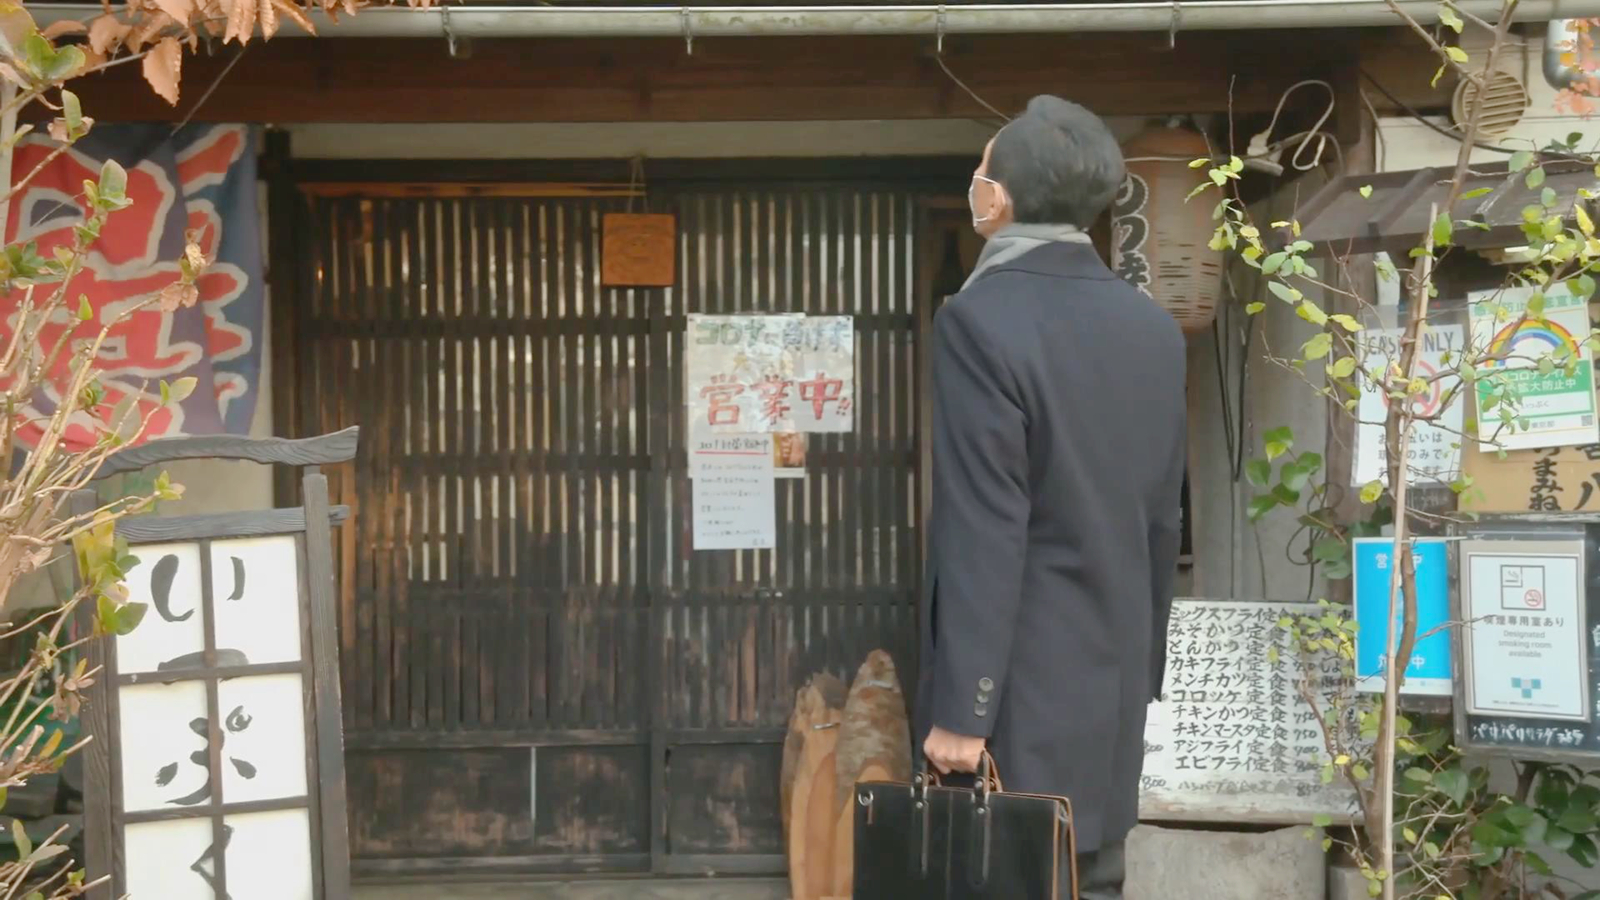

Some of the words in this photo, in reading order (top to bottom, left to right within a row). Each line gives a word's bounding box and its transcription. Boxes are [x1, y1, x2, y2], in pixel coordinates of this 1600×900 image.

[1424, 332, 1454, 352] NLY
[1503, 630, 1546, 639] Designated
[1498, 640, 1530, 648] smoking
[1508, 650, 1542, 658] available
[1172, 704, 1289, 724] チキンかつ定食
[1293, 728, 1317, 742] 750
[1173, 739, 1288, 758] アジフライ定食
[1174, 755, 1289, 774] エビフライ定食
